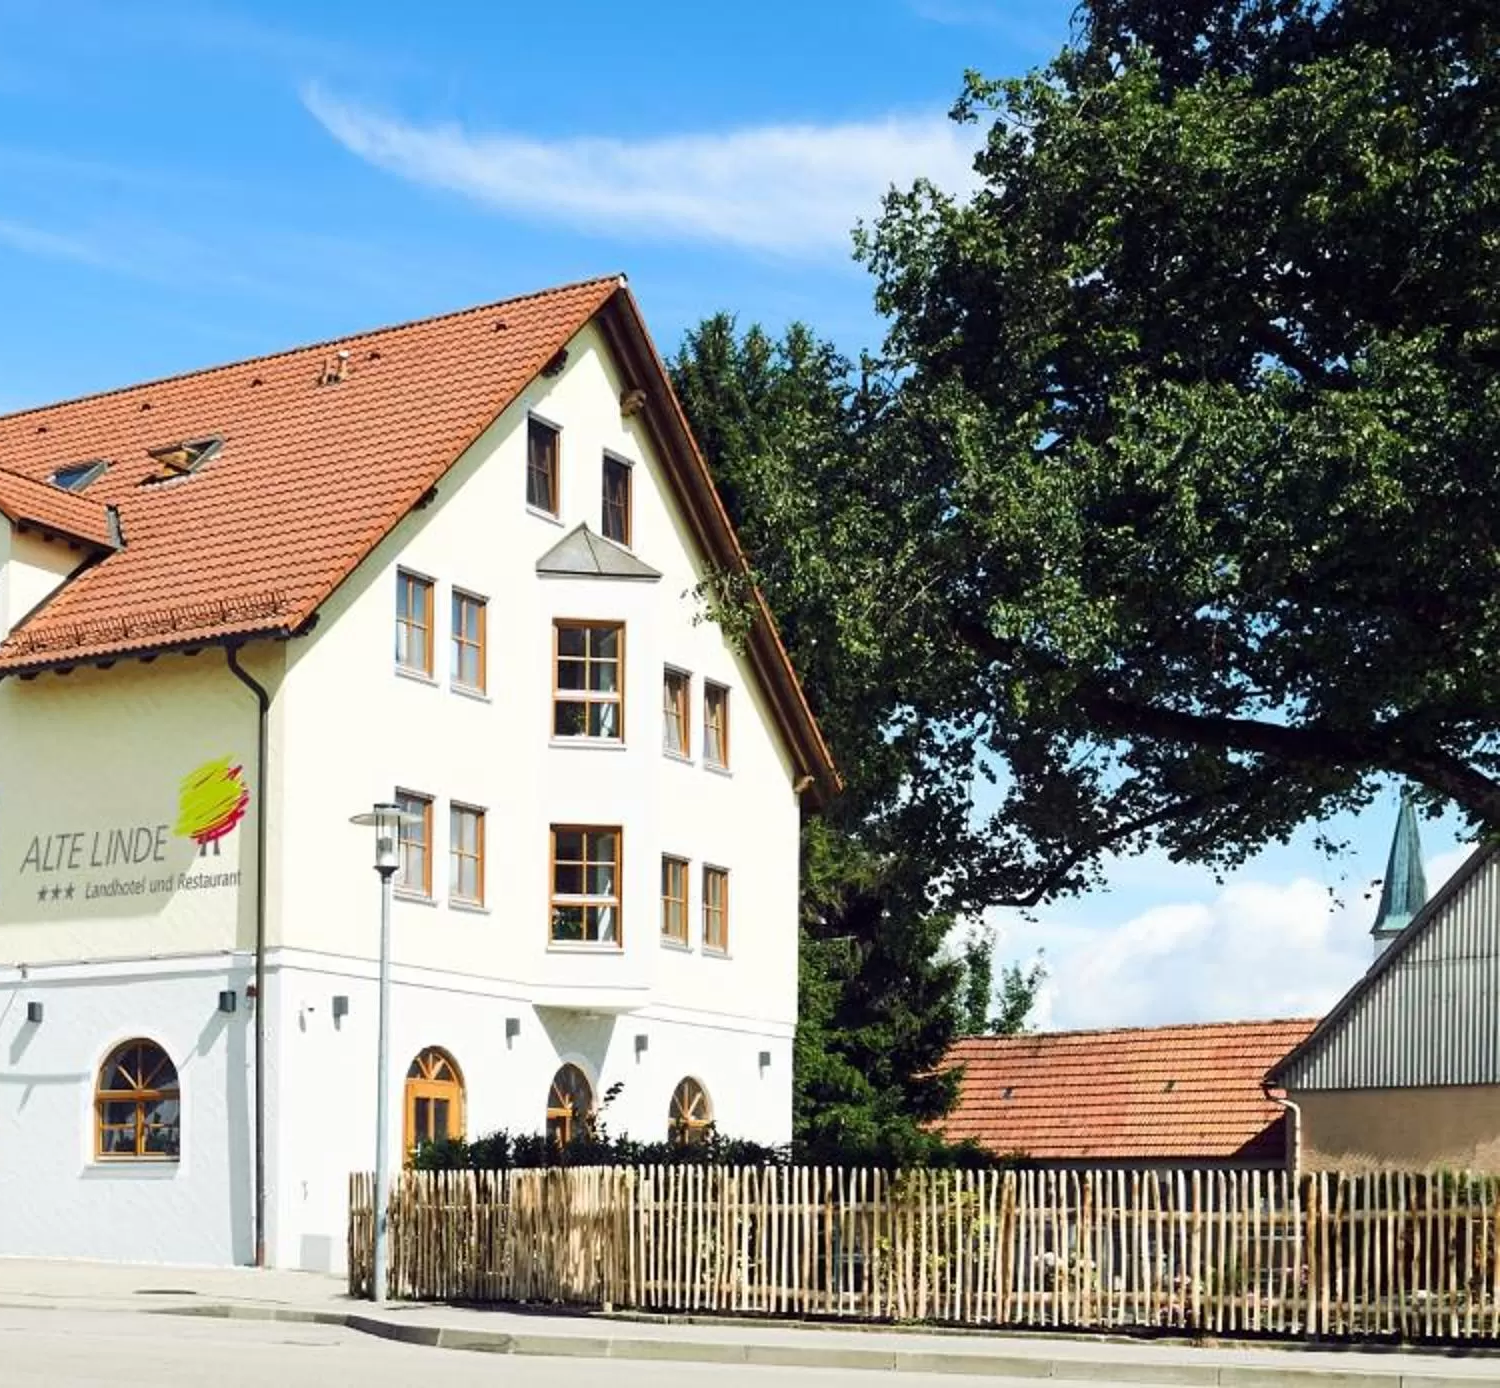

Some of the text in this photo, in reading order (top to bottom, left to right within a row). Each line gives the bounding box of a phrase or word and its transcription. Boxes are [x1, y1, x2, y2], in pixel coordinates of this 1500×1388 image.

[20, 824, 169, 874] ALTE LINDE
[85, 870, 242, 899] Landhotel und Restaurant
